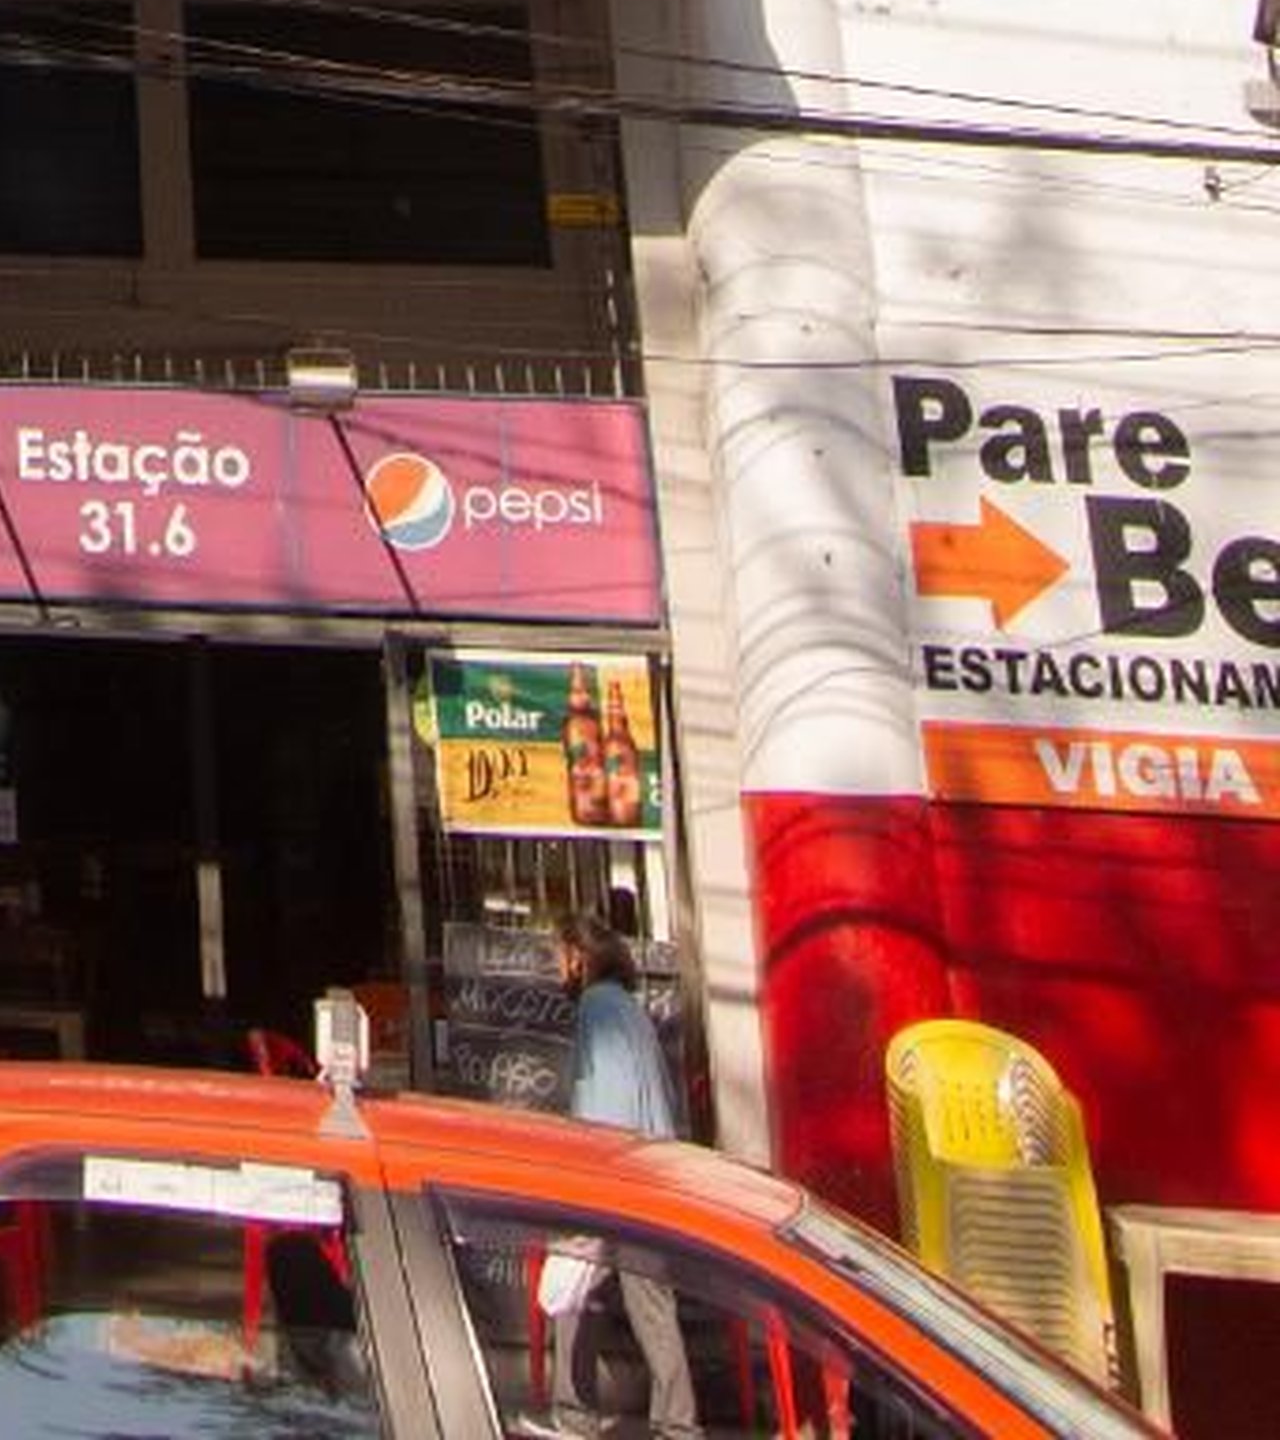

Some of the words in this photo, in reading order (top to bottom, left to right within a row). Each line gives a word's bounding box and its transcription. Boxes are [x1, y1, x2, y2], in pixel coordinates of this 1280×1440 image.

[17, 429, 250, 496] Estação
[891, 375, 1192, 490] Pare
[80, 501, 196, 557] 31.6
[463, 481, 603, 530] pepsi
[466, 701, 544, 729] Polar
[1035, 739, 1261, 805] VIGIA
